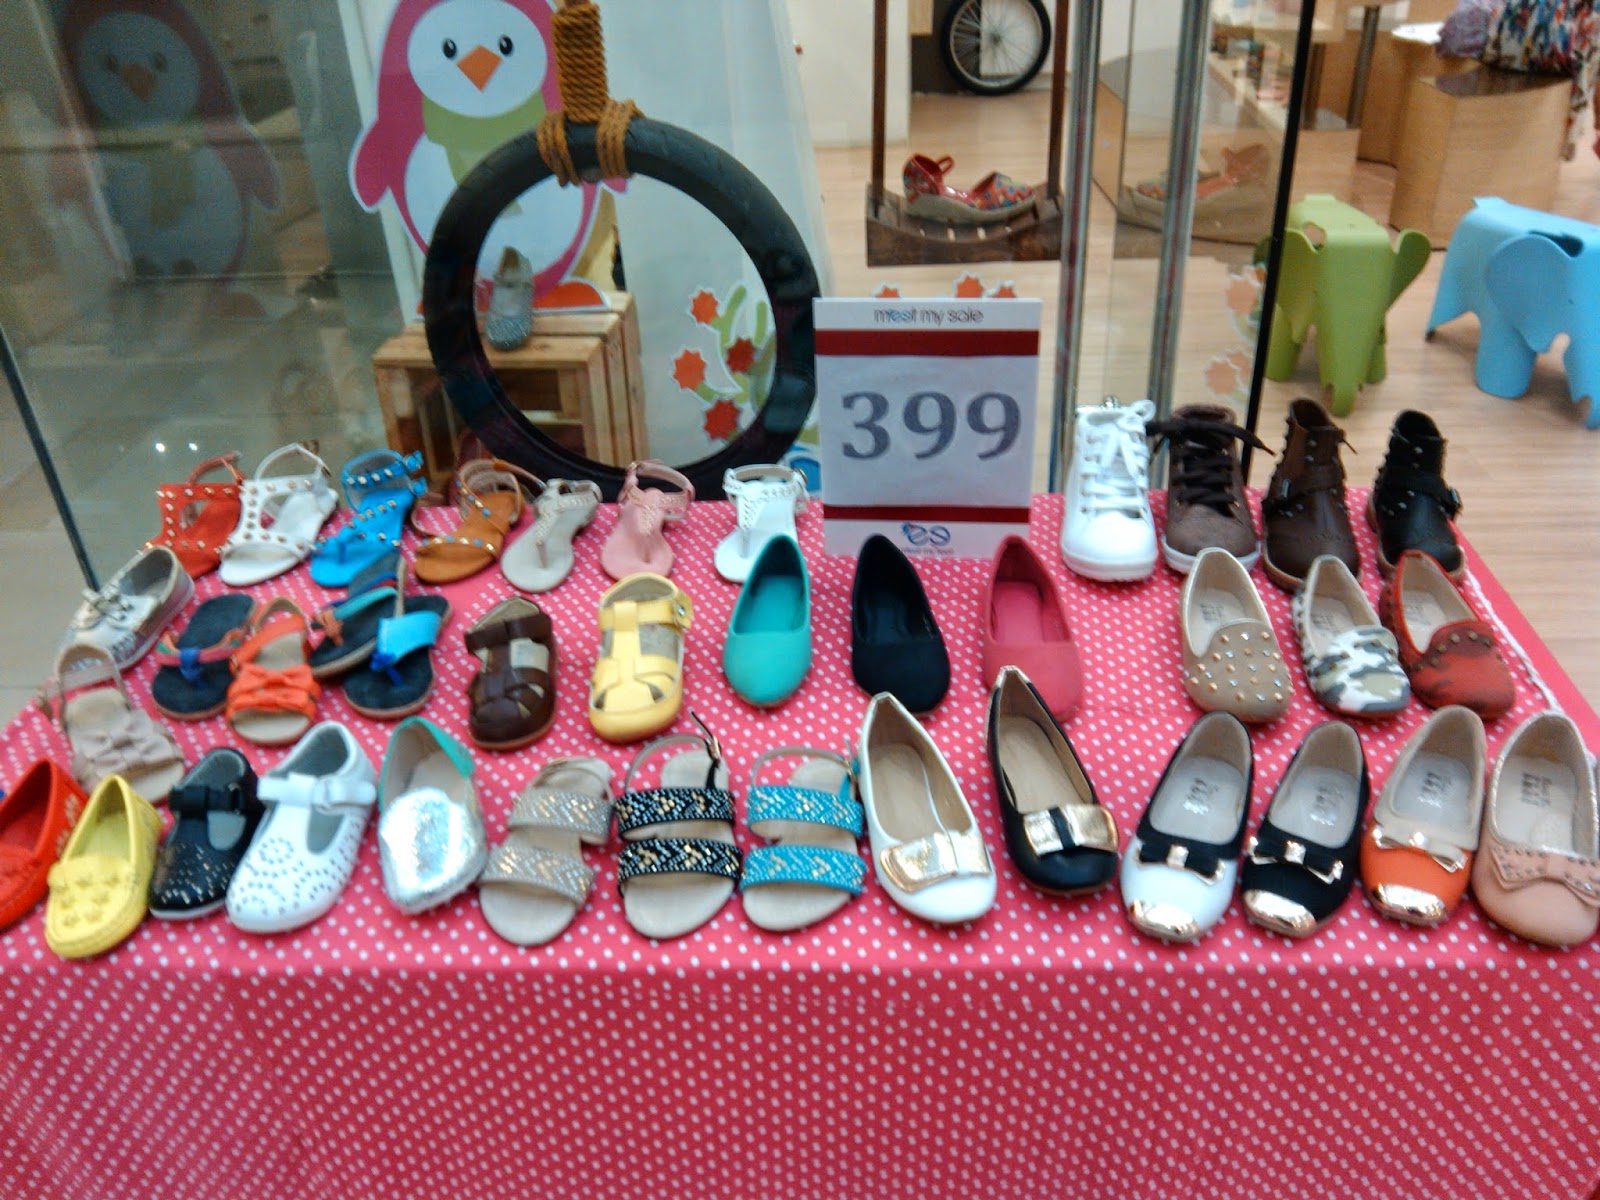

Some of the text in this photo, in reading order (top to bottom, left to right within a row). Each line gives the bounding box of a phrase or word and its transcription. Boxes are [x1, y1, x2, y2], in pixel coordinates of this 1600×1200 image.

[920, 309, 944, 326] my
[947, 306, 984, 323] sale
[841, 391, 1022, 460] 399
